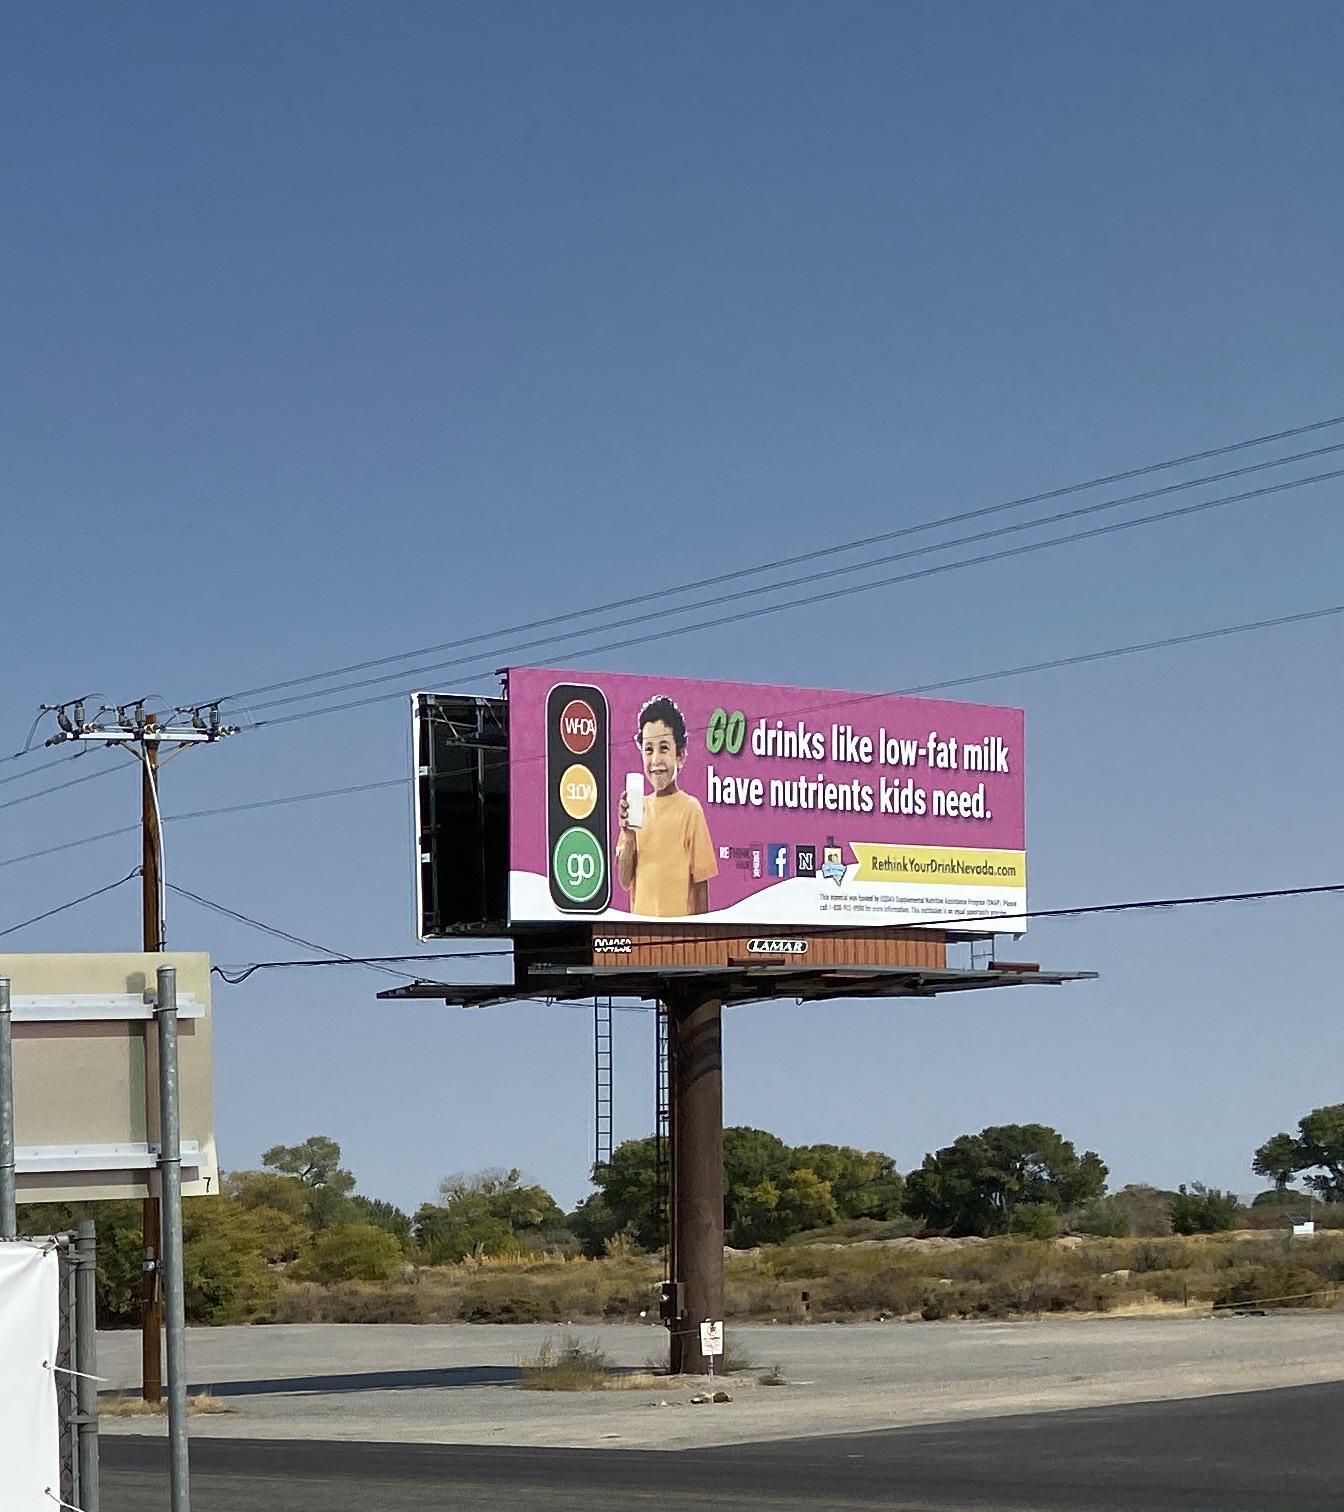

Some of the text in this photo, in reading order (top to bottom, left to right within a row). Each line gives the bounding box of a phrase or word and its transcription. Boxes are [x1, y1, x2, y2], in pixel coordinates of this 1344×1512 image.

[565, 717, 597, 736] WHOA
[705, 708, 1009, 774] GO drinks like low-fat milk
[707, 765, 992, 819] have nutrients kids need.
[567, 853, 595, 886] go
[871, 856, 1017, 877] RethinkYourDrinkNevada.com
[750, 940, 804, 952] LAMAR
[202, 1176, 212, 1194] 7
